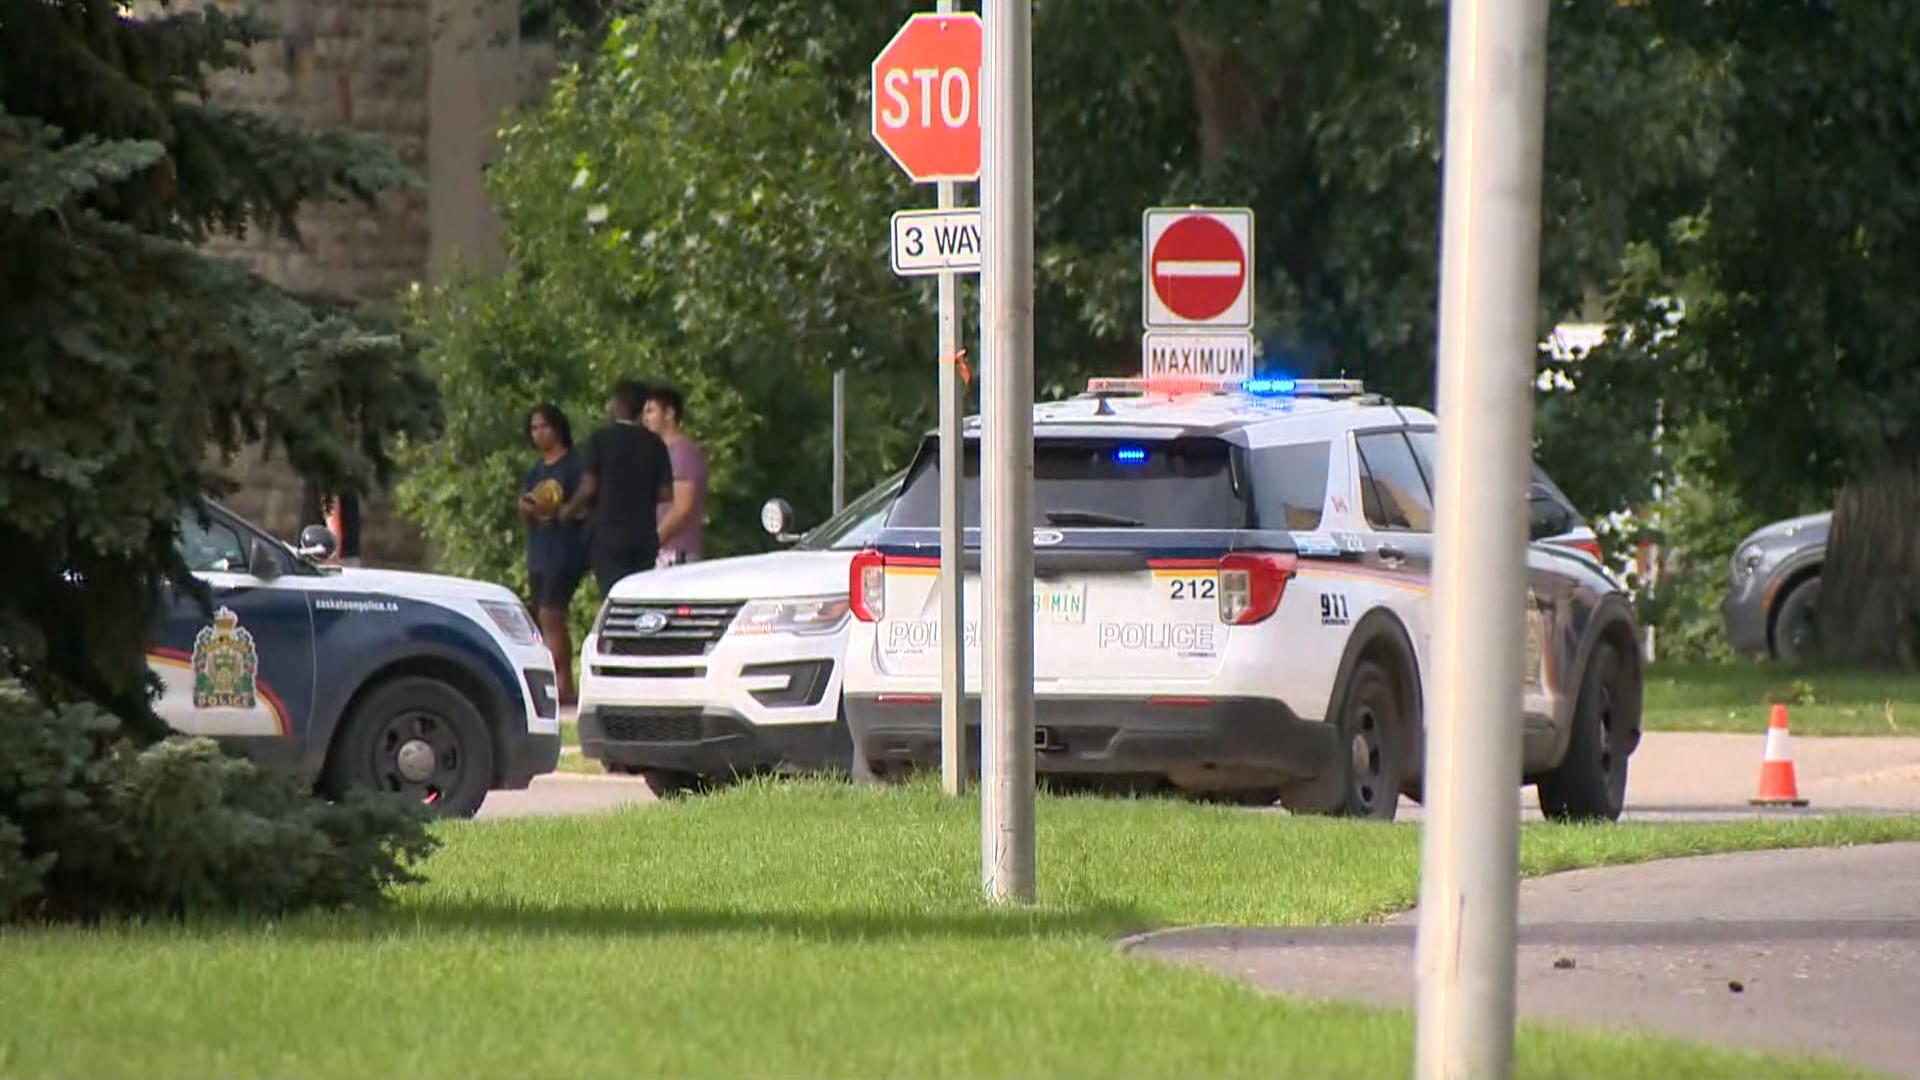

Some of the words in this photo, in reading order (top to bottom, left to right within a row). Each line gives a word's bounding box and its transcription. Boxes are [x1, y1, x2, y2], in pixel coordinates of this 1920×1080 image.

[881, 66, 981, 128] STO
[905, 226, 924, 256] 3
[1151, 348, 1245, 375] MAXIMUM
[1170, 579, 1215, 599] 212
[1051, 593, 1081, 613] MIN
[1321, 592, 1348, 618] 911
[1098, 621, 1215, 650] POLICE
